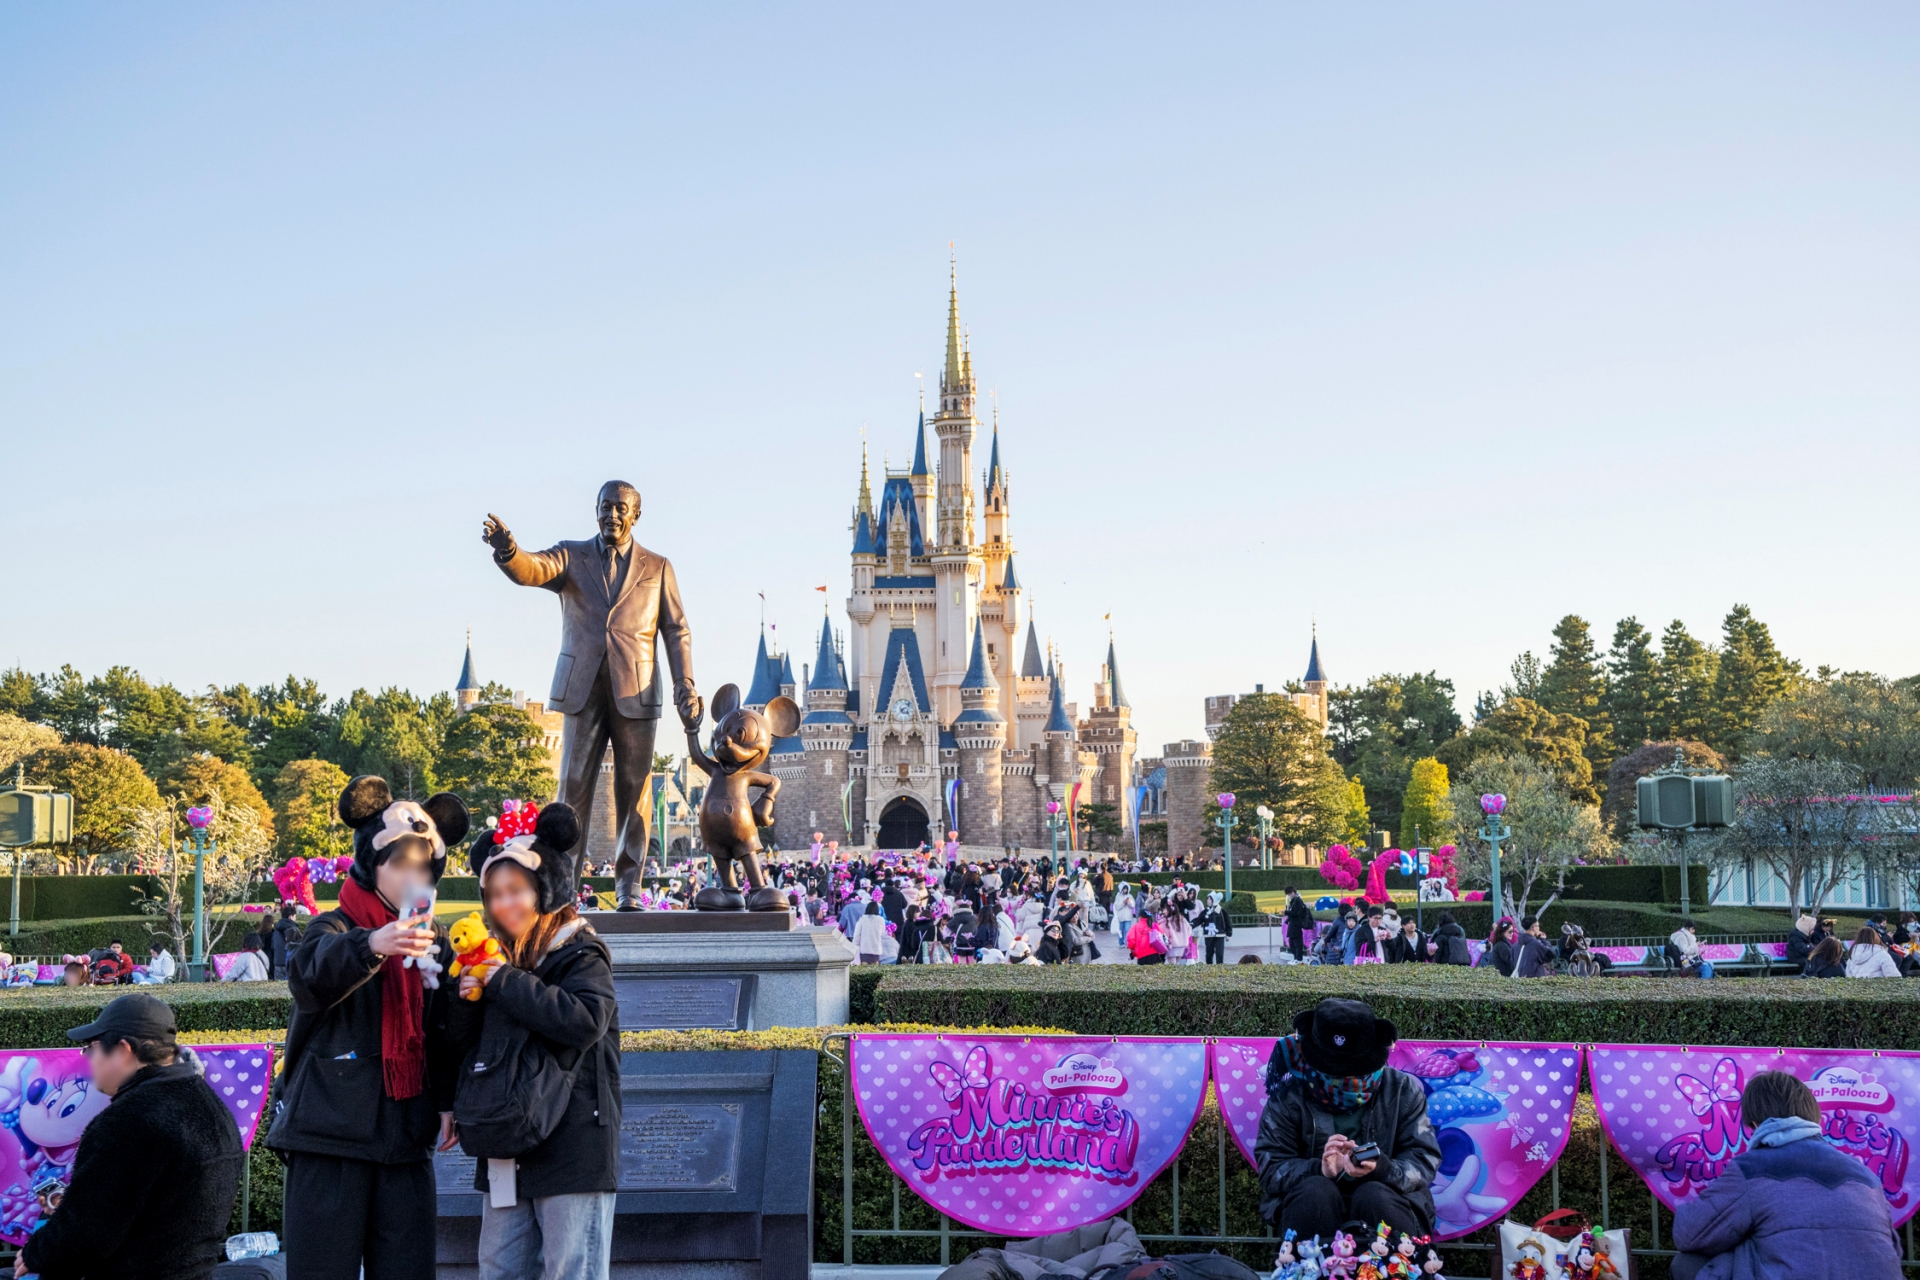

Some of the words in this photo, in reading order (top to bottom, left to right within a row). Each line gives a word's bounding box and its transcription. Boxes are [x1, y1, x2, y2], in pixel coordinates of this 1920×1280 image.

[1069, 1060, 1097, 1072] Disney
[1050, 1073, 1116, 1084] Pal-Palooza
[1826, 1073, 1857, 1087] Disney
[951, 1077, 1123, 1139] Minnie's
[907, 1109, 1136, 1174] Funderland
